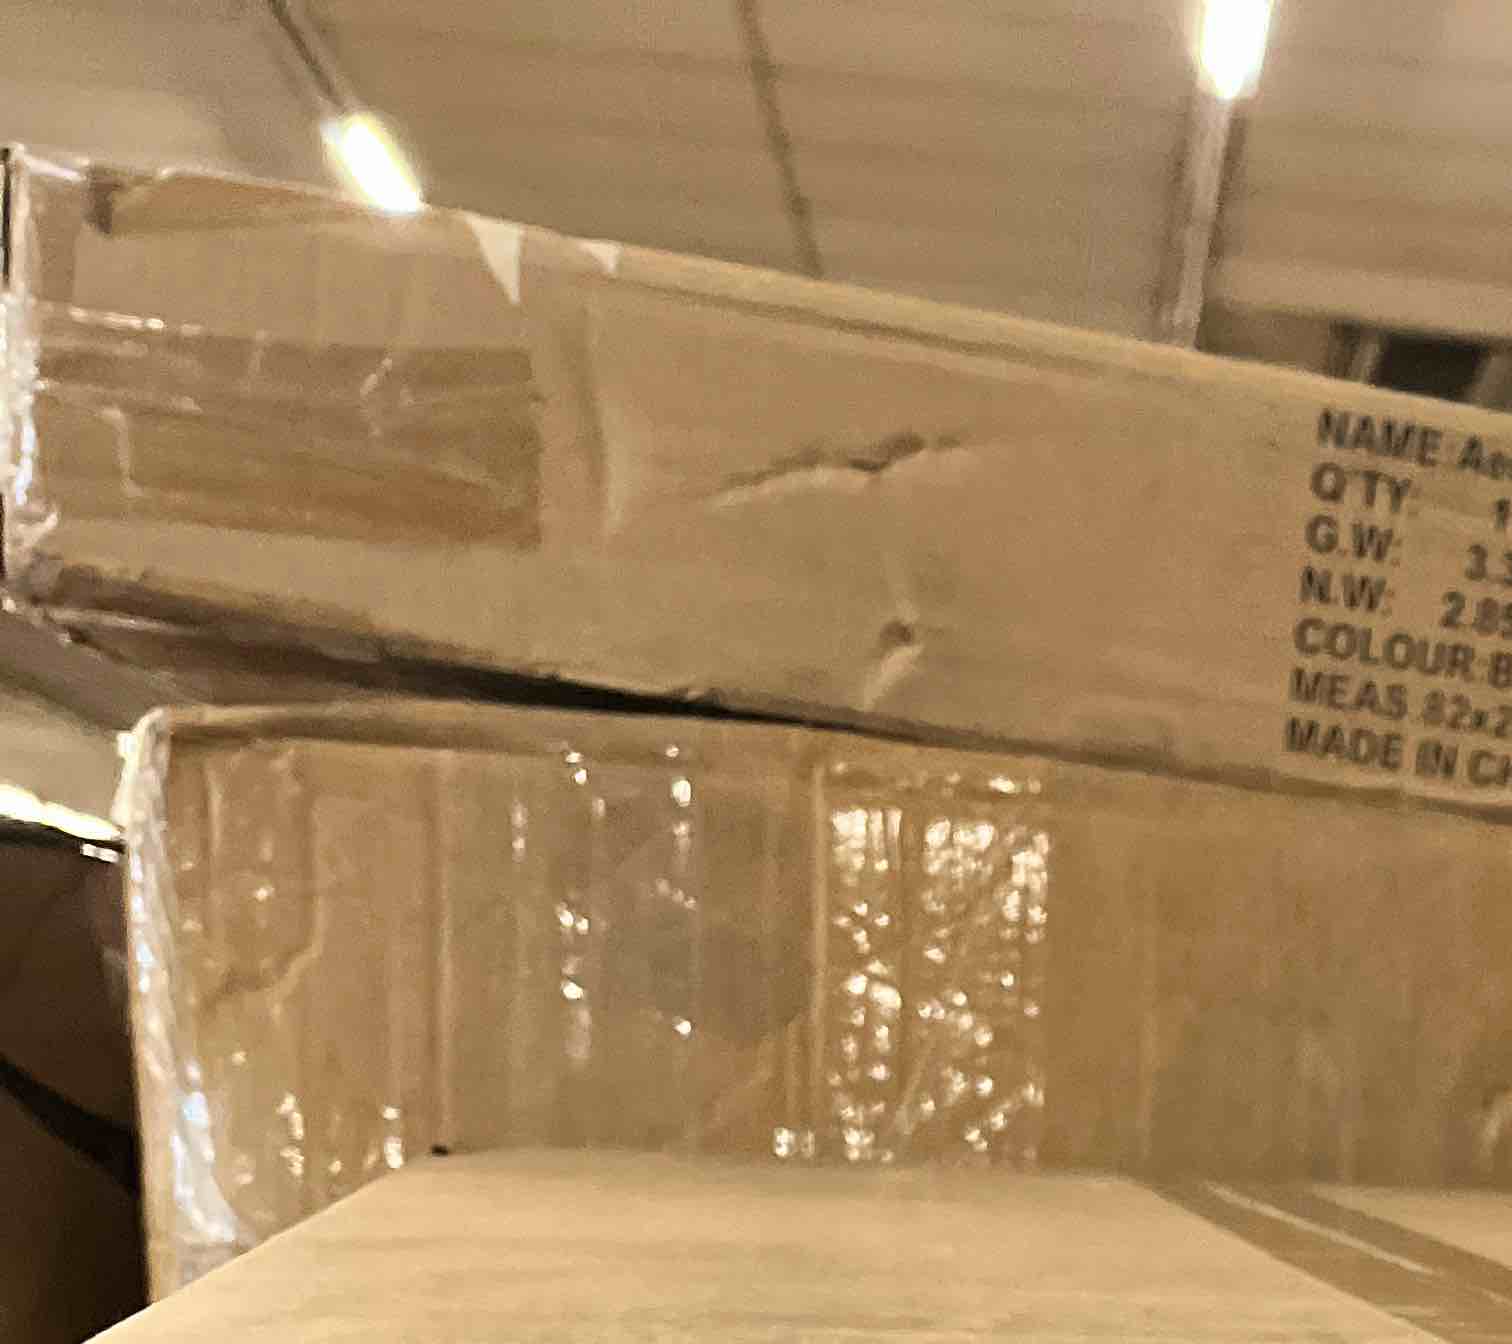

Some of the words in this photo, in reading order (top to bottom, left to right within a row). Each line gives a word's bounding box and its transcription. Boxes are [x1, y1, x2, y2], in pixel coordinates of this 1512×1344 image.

[1493, 497, 1512, 532] 1
[1283, 716, 1404, 771] MADE
[1415, 737, 1458, 780] IN
